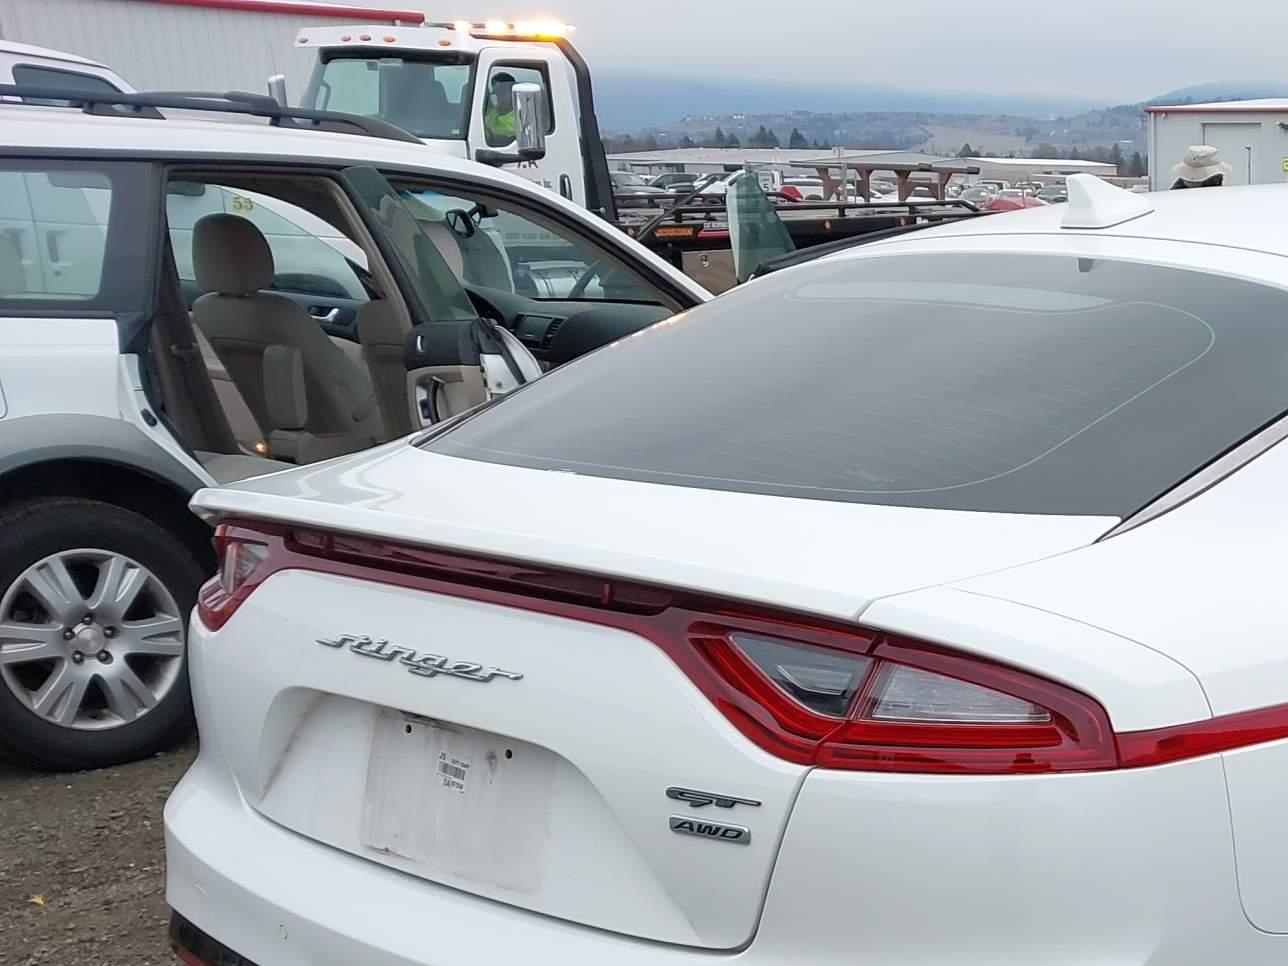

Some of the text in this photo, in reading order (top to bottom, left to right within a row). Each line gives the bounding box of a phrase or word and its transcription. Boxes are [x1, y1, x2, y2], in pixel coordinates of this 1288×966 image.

[315, 632, 524, 683] Stinger
[665, 786, 762, 808] GT
[673, 821, 743, 839] AWD
